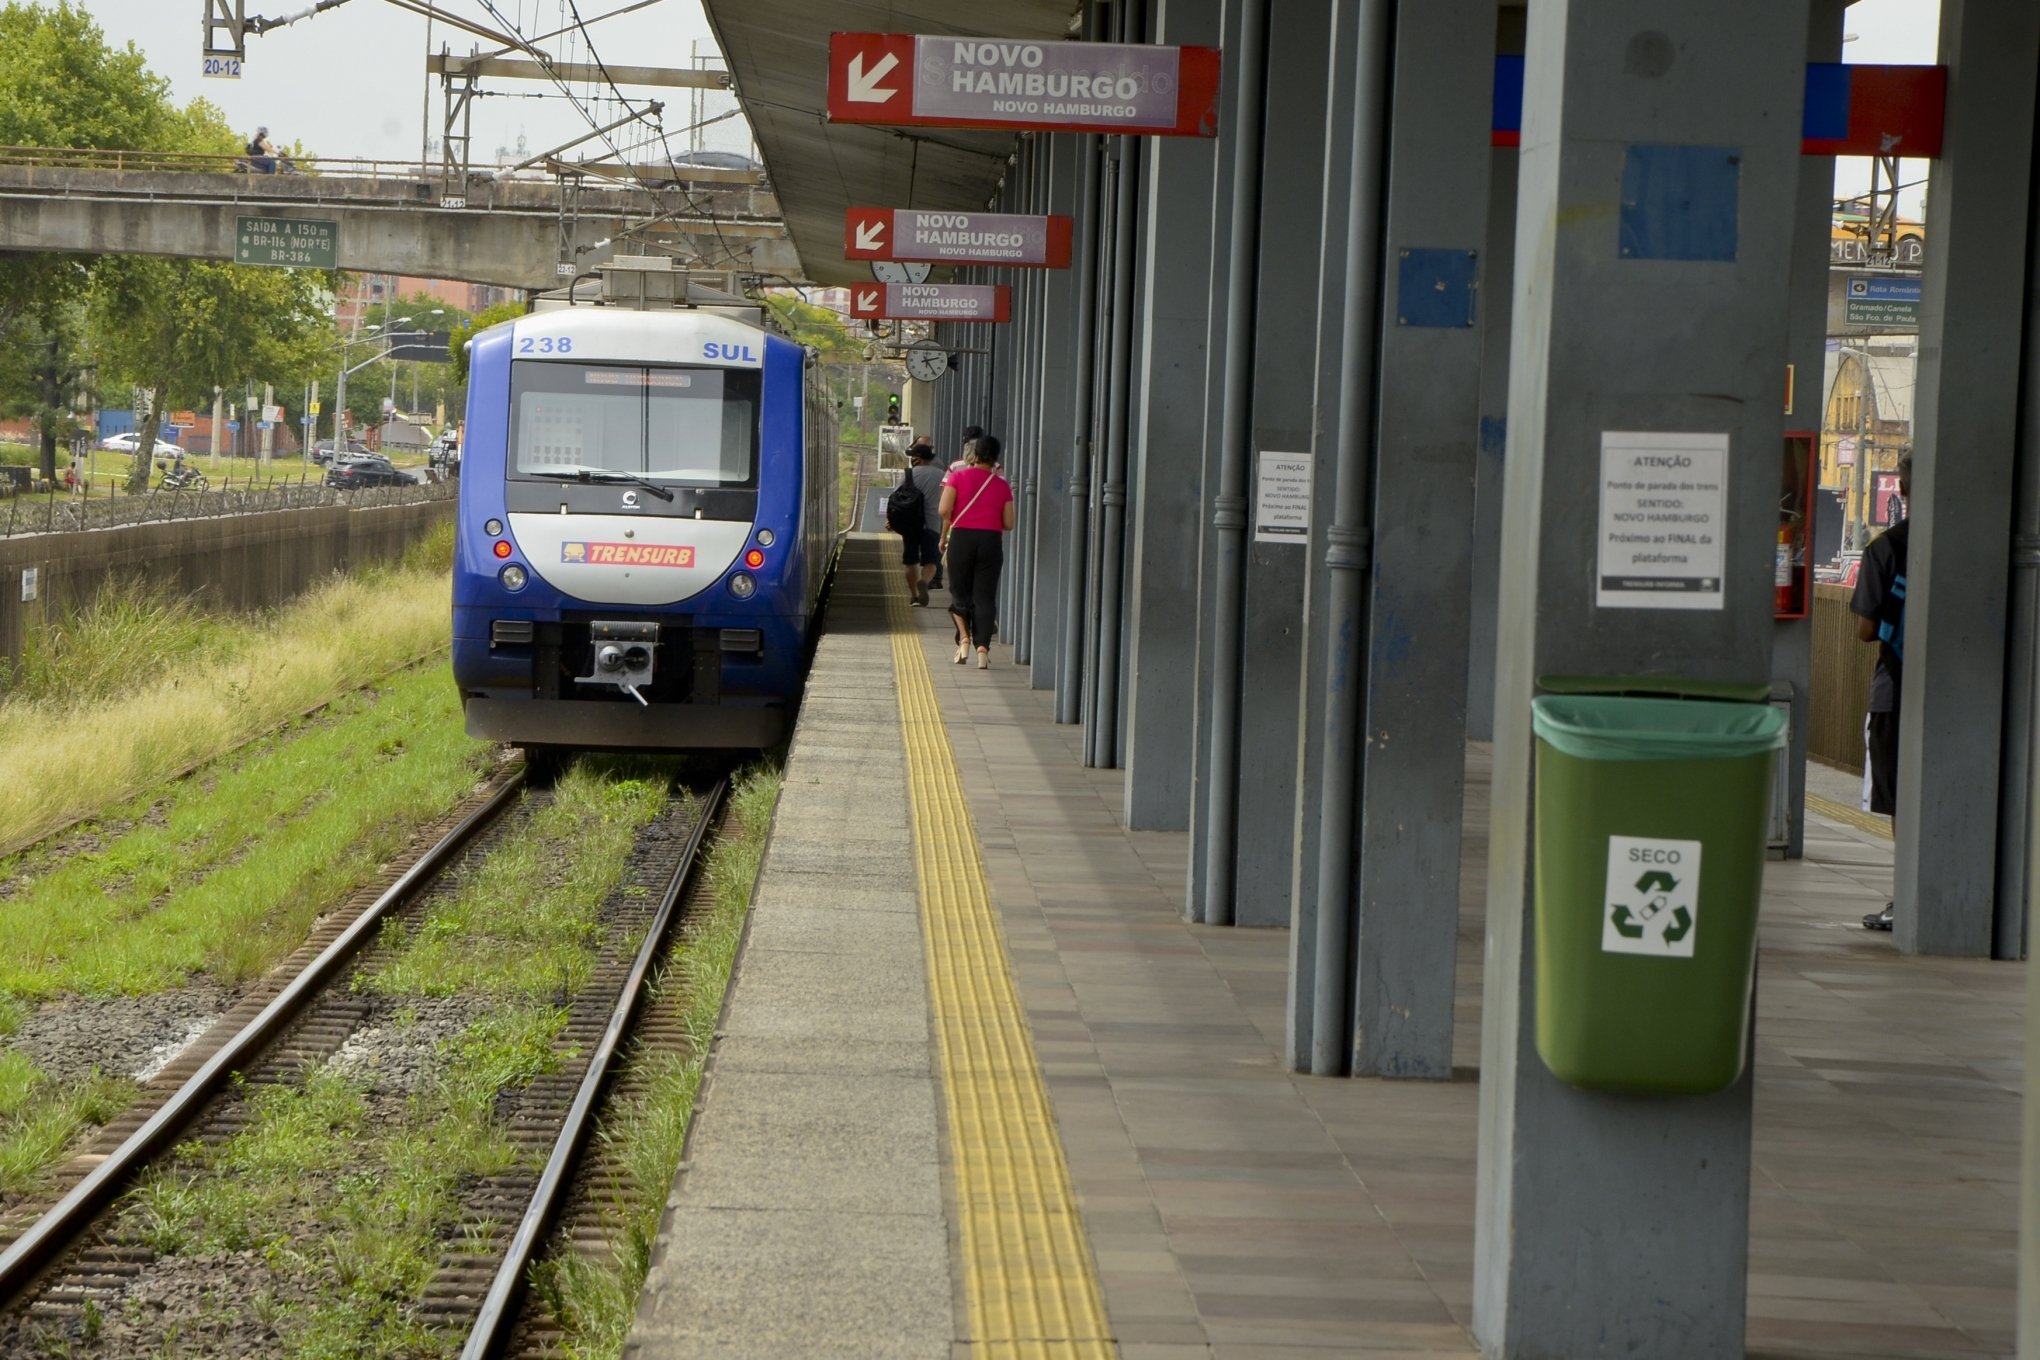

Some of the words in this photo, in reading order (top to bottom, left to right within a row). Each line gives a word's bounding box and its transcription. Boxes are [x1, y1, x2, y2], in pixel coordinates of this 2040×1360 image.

[953, 42, 1044, 68] NOVO
[204, 59, 239, 75] 20-12
[953, 70, 1138, 100] HAMBURGO
[993, 100, 1038, 114] NOVO
[1043, 102, 1137, 118] HAMBURGO
[246, 219, 277, 233] SAÍDA
[285, 223, 291, 234] A
[298, 224, 317, 235] 150
[916, 214, 969, 229] NOVO
[253, 235, 286, 247] BR-116
[916, 230, 1023, 248] HAMBURGO
[271, 250, 311, 262] BR-386
[939, 247, 966, 255] NOVO
[968, 248, 1023, 258] HAMBURGO
[1867, 255, 1890, 266] 21-12
[902, 286, 939, 297] NOVO
[902, 298, 978, 309] HAMBURGO
[1850, 303, 1912, 313] Gramado/Canela
[1883, 314, 1893, 322] de
[1896, 315, 1916, 323] Paula
[519, 337, 572, 353] 238
[703, 342, 757, 362] SUL
[1634, 455, 1692, 469] ATENÇÃO
[1613, 513, 1645, 522] NOVO
[1647, 513, 1709, 523] HAMBURGO
[1668, 534, 1697, 544] FINAL
[1699, 534, 1712, 544] da
[590, 545, 692, 565] TRENSURB
[1628, 847, 1682, 865] SECO
